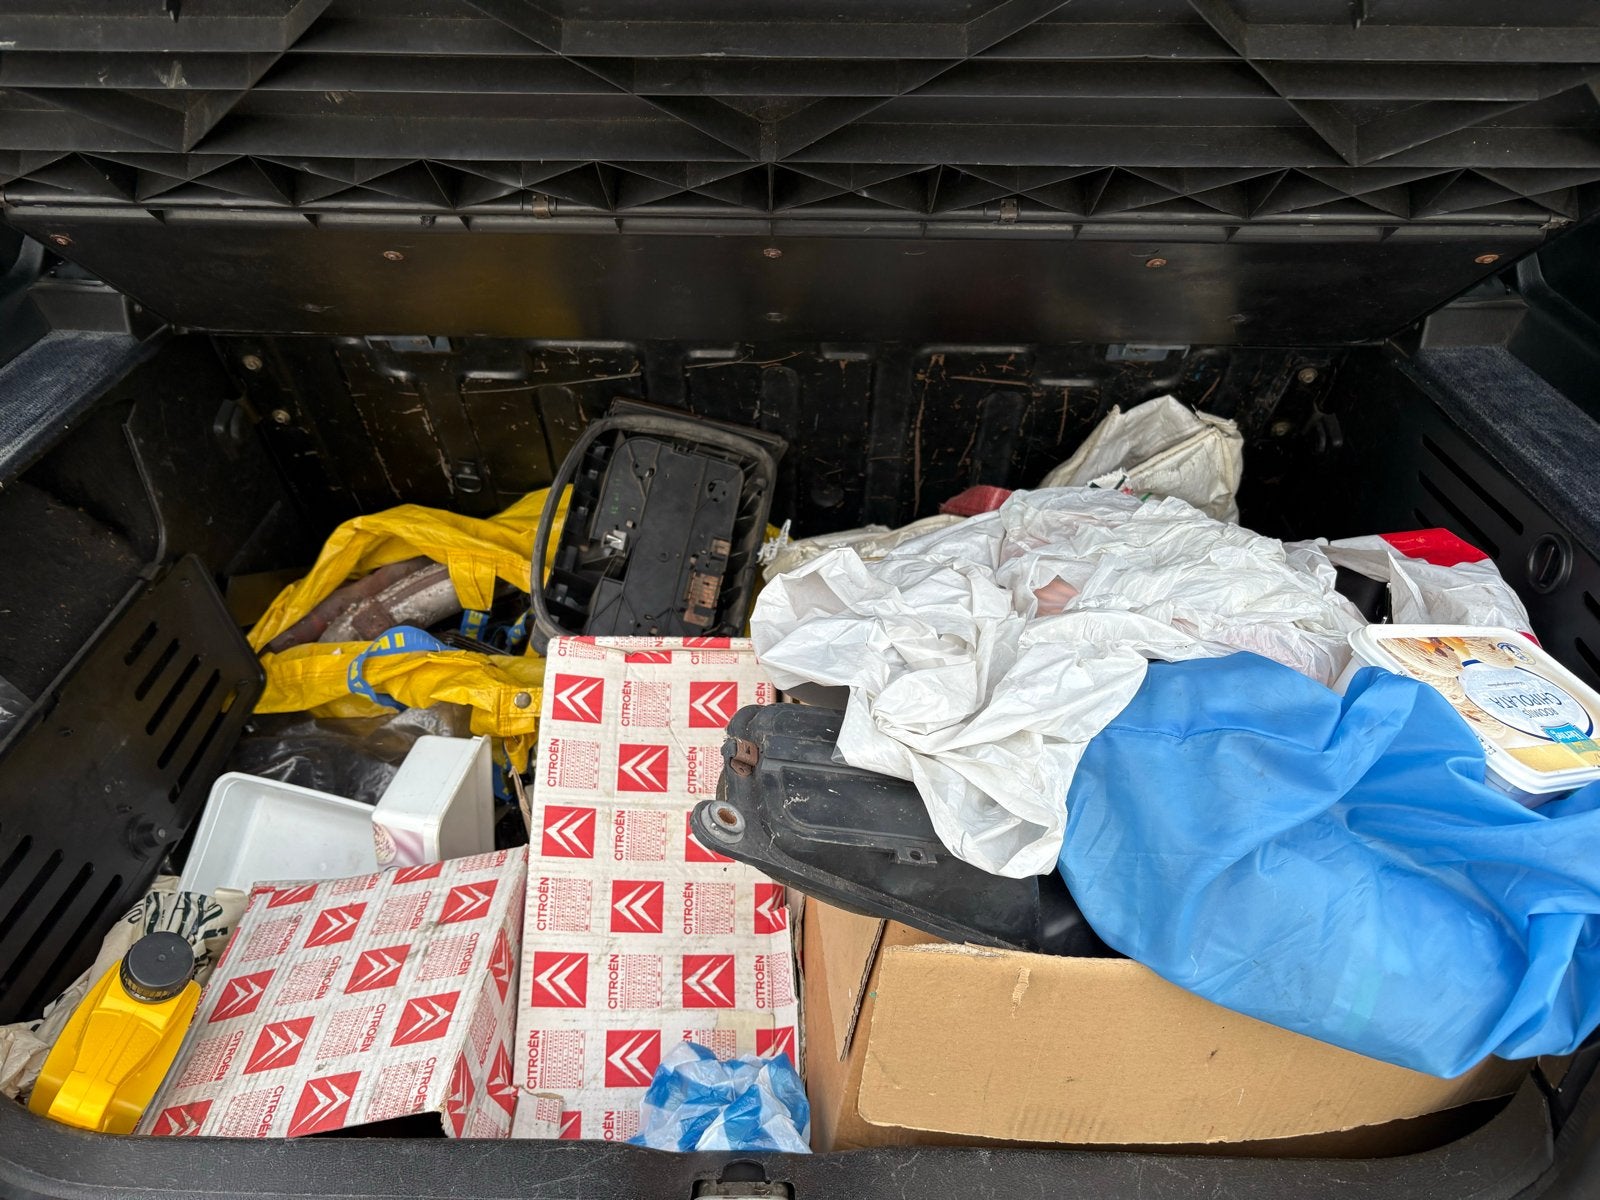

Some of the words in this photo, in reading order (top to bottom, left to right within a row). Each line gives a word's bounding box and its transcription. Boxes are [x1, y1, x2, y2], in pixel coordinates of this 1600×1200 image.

[621, 680, 632, 727] CITROËN
[1488, 692, 1562, 709] CHIPOLATA
[547, 738, 560, 787] CITROËN
[687, 746, 698, 794] CITROËN
[614, 810, 625, 861] CITROËN
[409, 890, 432, 930] CITROËN
[536, 877, 549, 931] CITROËN
[684, 882, 694, 934] CITROËN
[313, 955, 342, 1000] CITROËN
[456, 932, 480, 976] CITROËN
[608, 954, 619, 1009] CITROËN
[755, 954, 765, 1009] CITROËN
[359, 1003, 387, 1053] CITROËN
[215, 1030, 244, 1081] CITROËN
[527, 1029, 540, 1090] CITROËN
[411, 1057, 437, 1113] CITROËN
